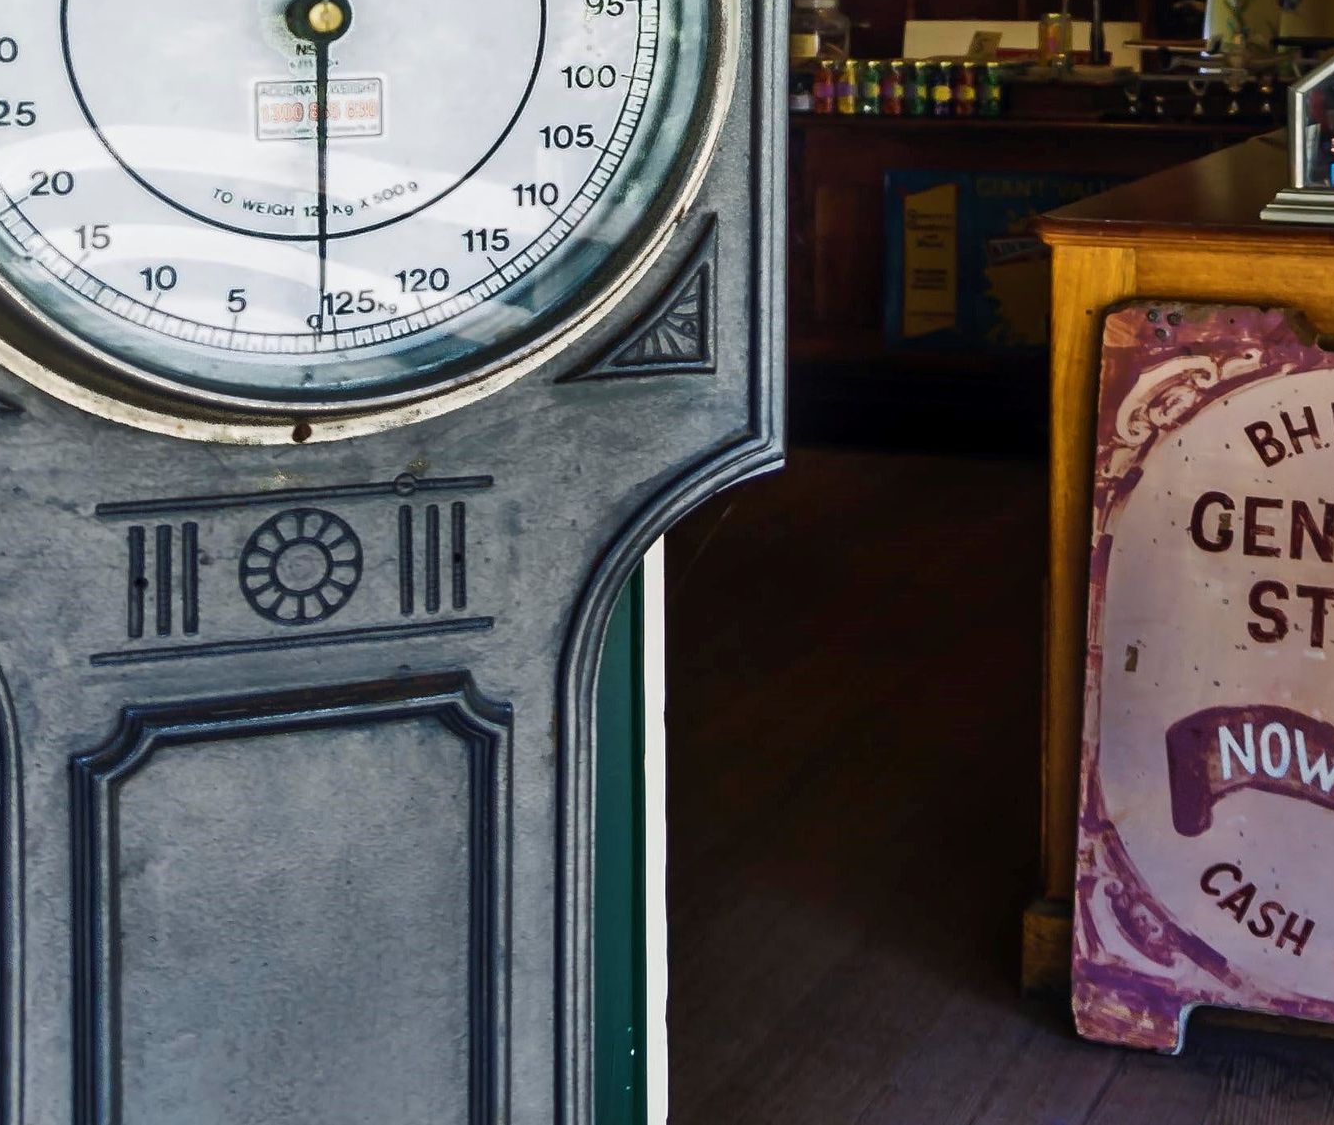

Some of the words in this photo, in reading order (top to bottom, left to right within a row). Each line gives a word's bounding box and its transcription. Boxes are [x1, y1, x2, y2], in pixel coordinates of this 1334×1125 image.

[561, 64, 617, 89] 100
[539, 125, 596, 151] 105
[29, 170, 75, 196] 20
[512, 182, 559, 208] 110
[213, 187, 233, 204] TO
[242, 199, 295, 217] WEIGH
[373, 184, 405, 200] 500
[74, 223, 112, 251] 15
[461, 227, 510, 254] 115
[140, 265, 178, 292] 10
[396, 267, 449, 293] 120
[227, 288, 247, 313] 5
[1199, 863, 1315, 956] CASH
